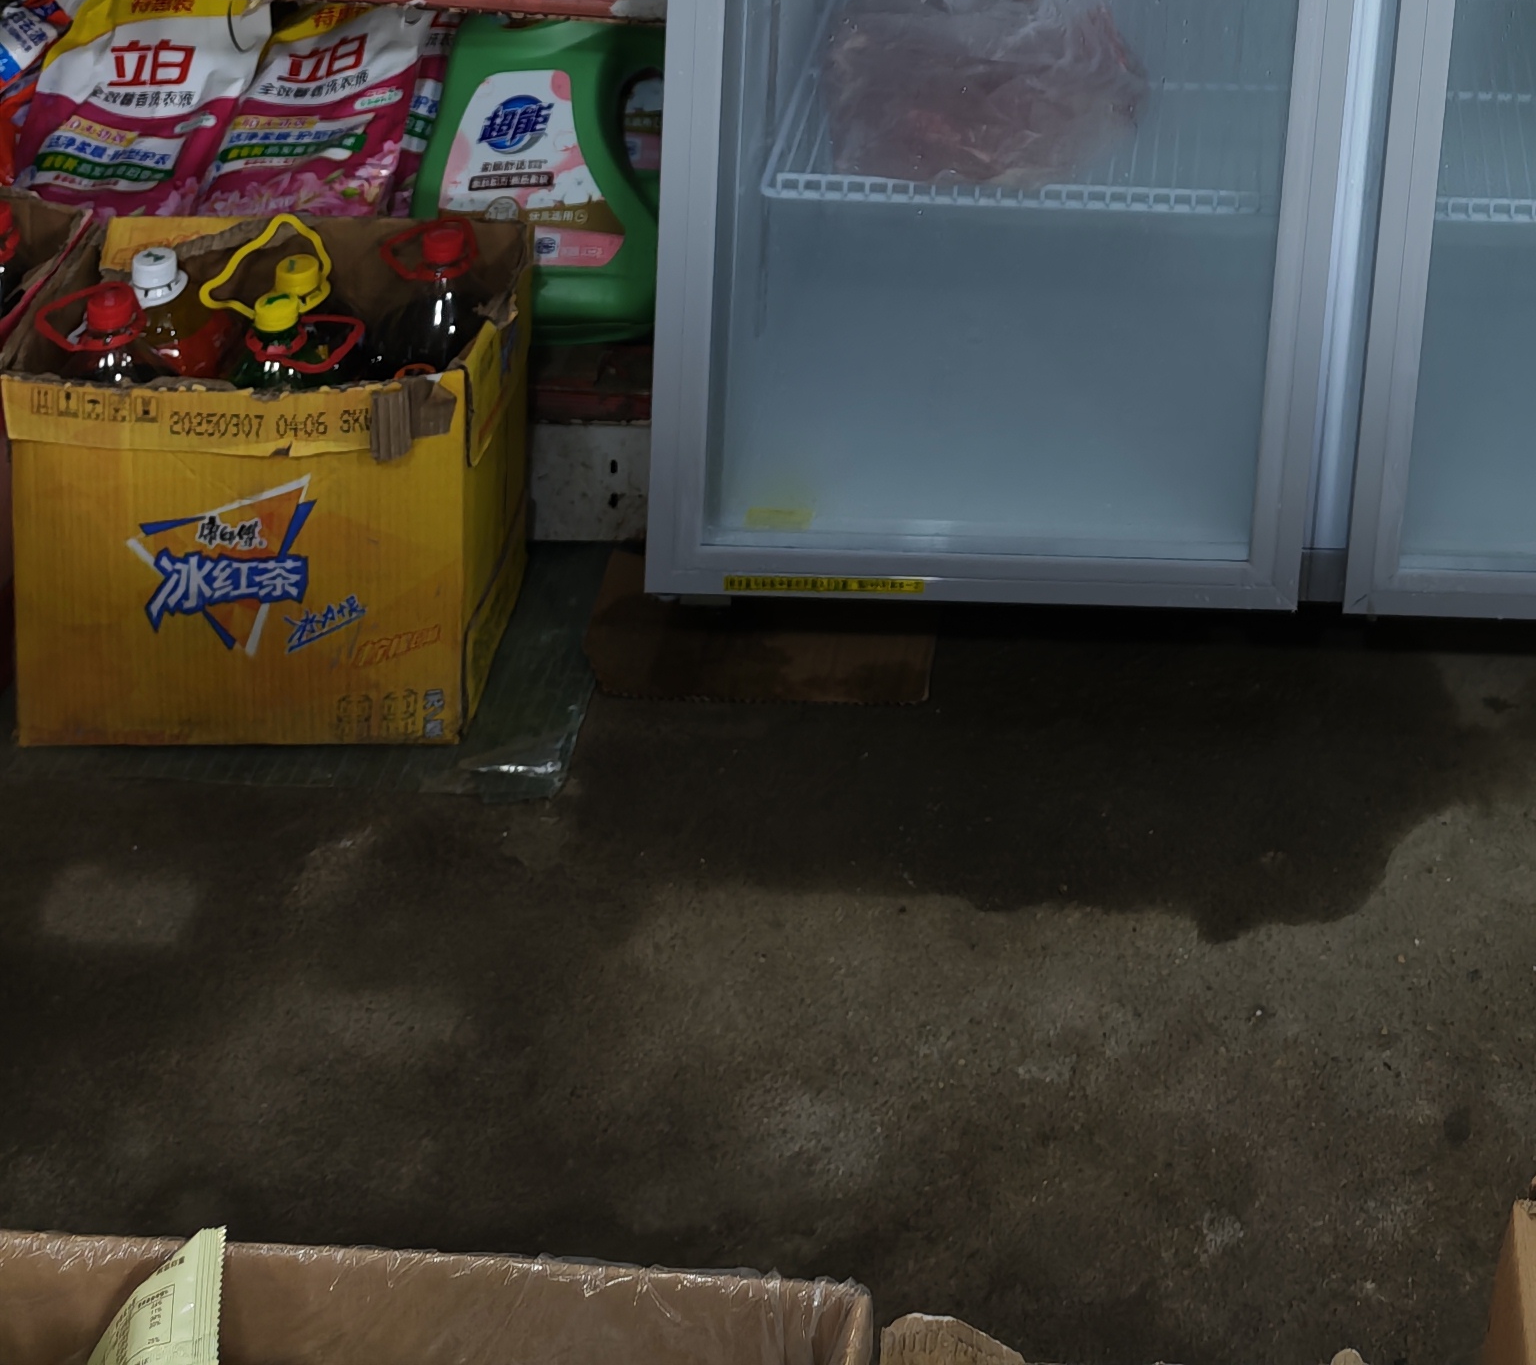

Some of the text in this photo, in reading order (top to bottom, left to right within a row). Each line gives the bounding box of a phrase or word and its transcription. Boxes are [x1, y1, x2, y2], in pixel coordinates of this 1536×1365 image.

[107, 38, 197, 88] 立白
[277, 32, 369, 84] 立白
[477, 102, 555, 145] 超能
[169, 411, 265, 438] 20250307
[149, 555, 302, 619] 冰红茶
